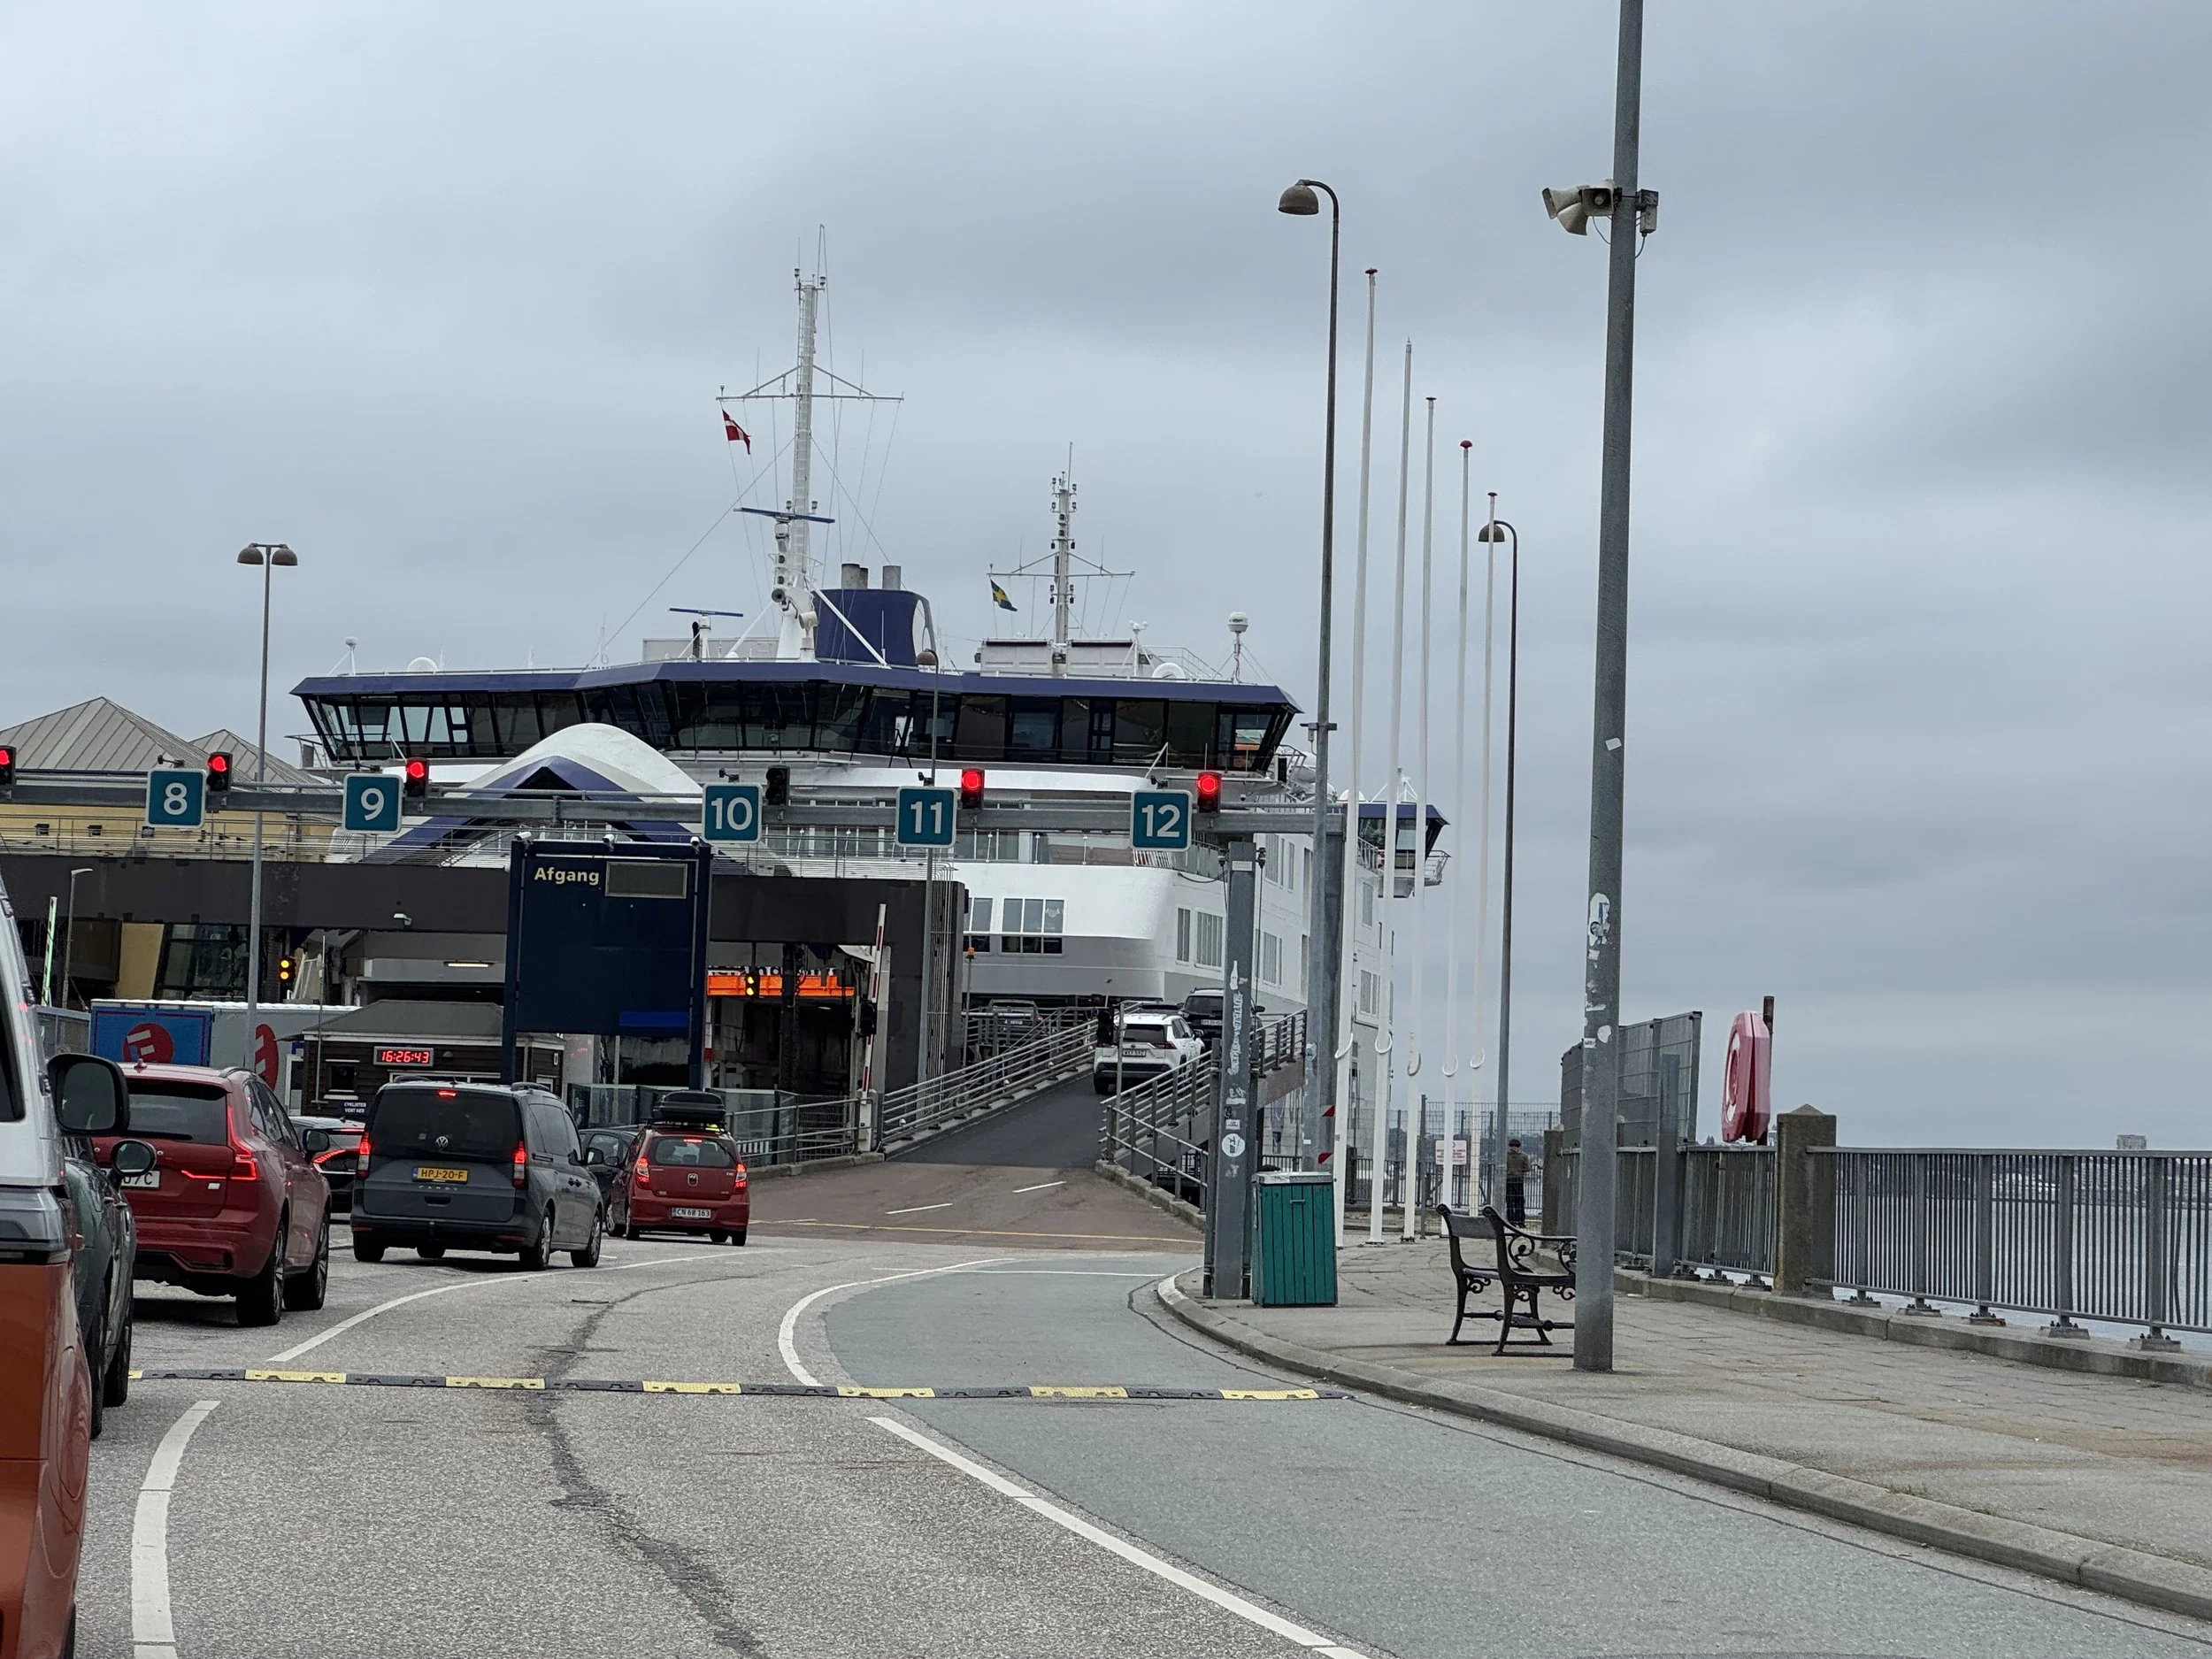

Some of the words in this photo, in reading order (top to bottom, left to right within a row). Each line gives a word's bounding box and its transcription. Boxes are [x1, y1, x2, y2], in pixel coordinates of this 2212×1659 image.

[163, 782, 188, 815] 8
[360, 787, 385, 821] 9
[710, 796, 753, 831] 10
[910, 801, 943, 834] 11
[1141, 803, 1180, 838] 12
[534, 866, 600, 886] Afgang
[381, 1050, 430, 1064] 16:26:43
[420, 1169, 465, 1179] HPJ-20-F
